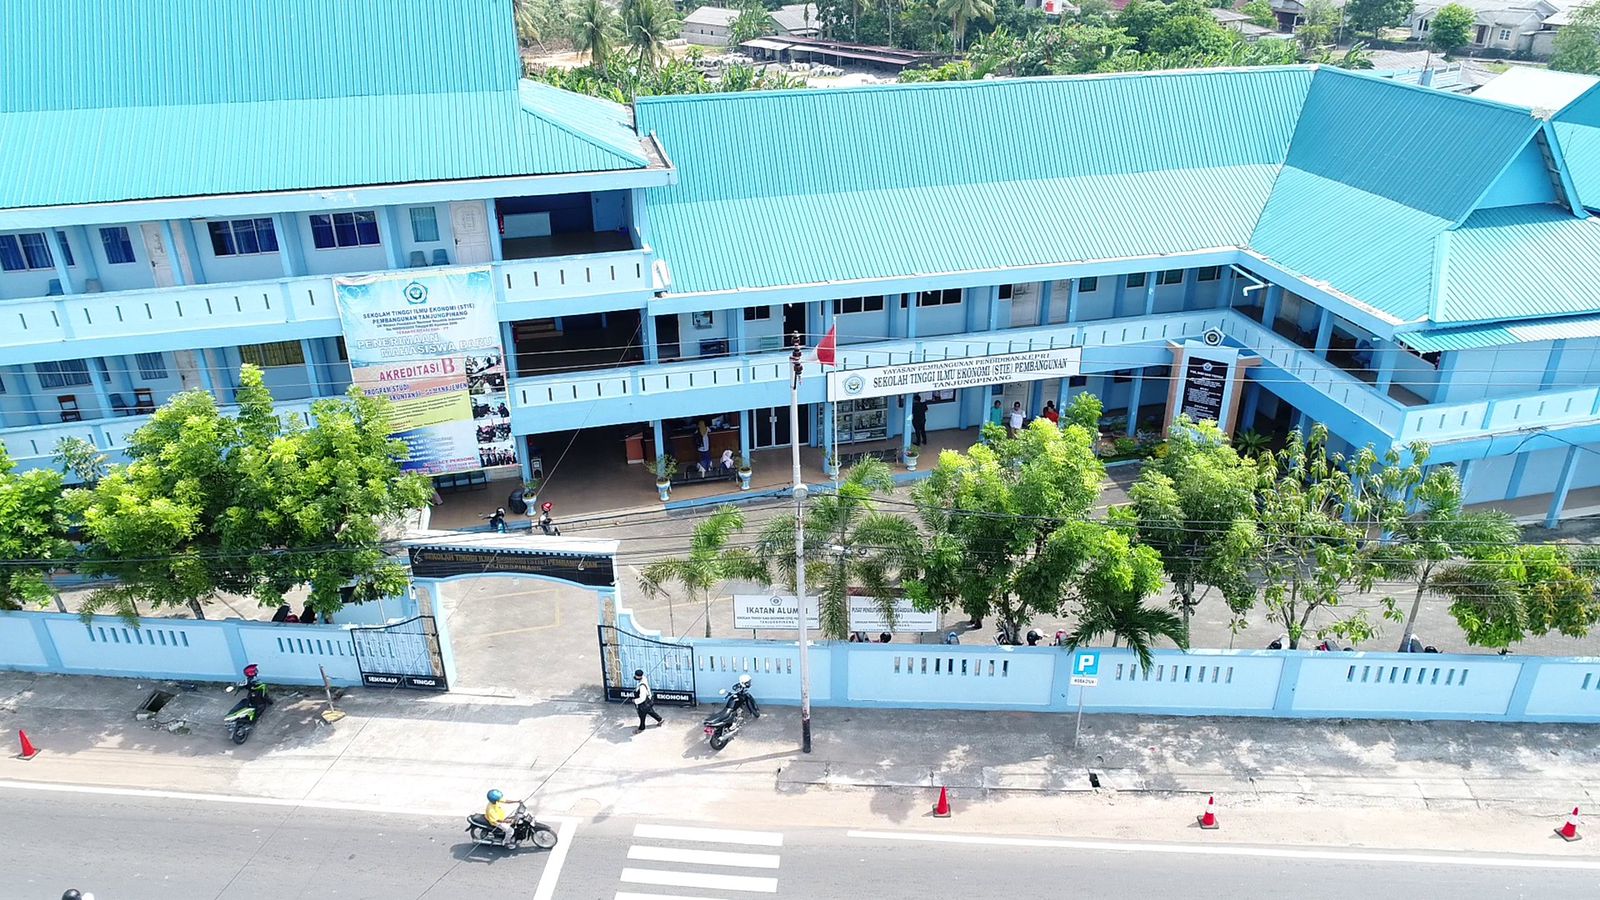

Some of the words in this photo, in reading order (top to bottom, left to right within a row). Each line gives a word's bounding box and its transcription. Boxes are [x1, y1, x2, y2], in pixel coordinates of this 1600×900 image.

[363, 311, 390, 319] SEKOLAH
[372, 316, 417, 324] PEMBANGUNAN
[420, 311, 468, 320] TANJUNGPINANG
[357, 333, 439, 350] PENERIMAAN
[380, 342, 457, 358] MAHASISWA
[379, 364, 439, 381] AKREDITASI
[441, 358, 455, 374] B
[918, 361, 973, 371] PEMBANGUNAN
[976, 355, 1019, 365] PENDIDIKAN
[873, 374, 909, 388] SEKOLAH
[910, 372, 935, 383] TINGGI
[937, 369, 955, 381] ILMU
[957, 366, 990, 379] EKONOMI
[992, 363, 1013, 376] (STIE)
[1015, 358, 1067, 372] PEMBANGUNAN
[932, 375, 1011, 388] TANJUNGPINANG
[364, 387, 391, 396] PROGRAM
[392, 384, 410, 392] STUDI
[1078, 655, 1095, 671] P
